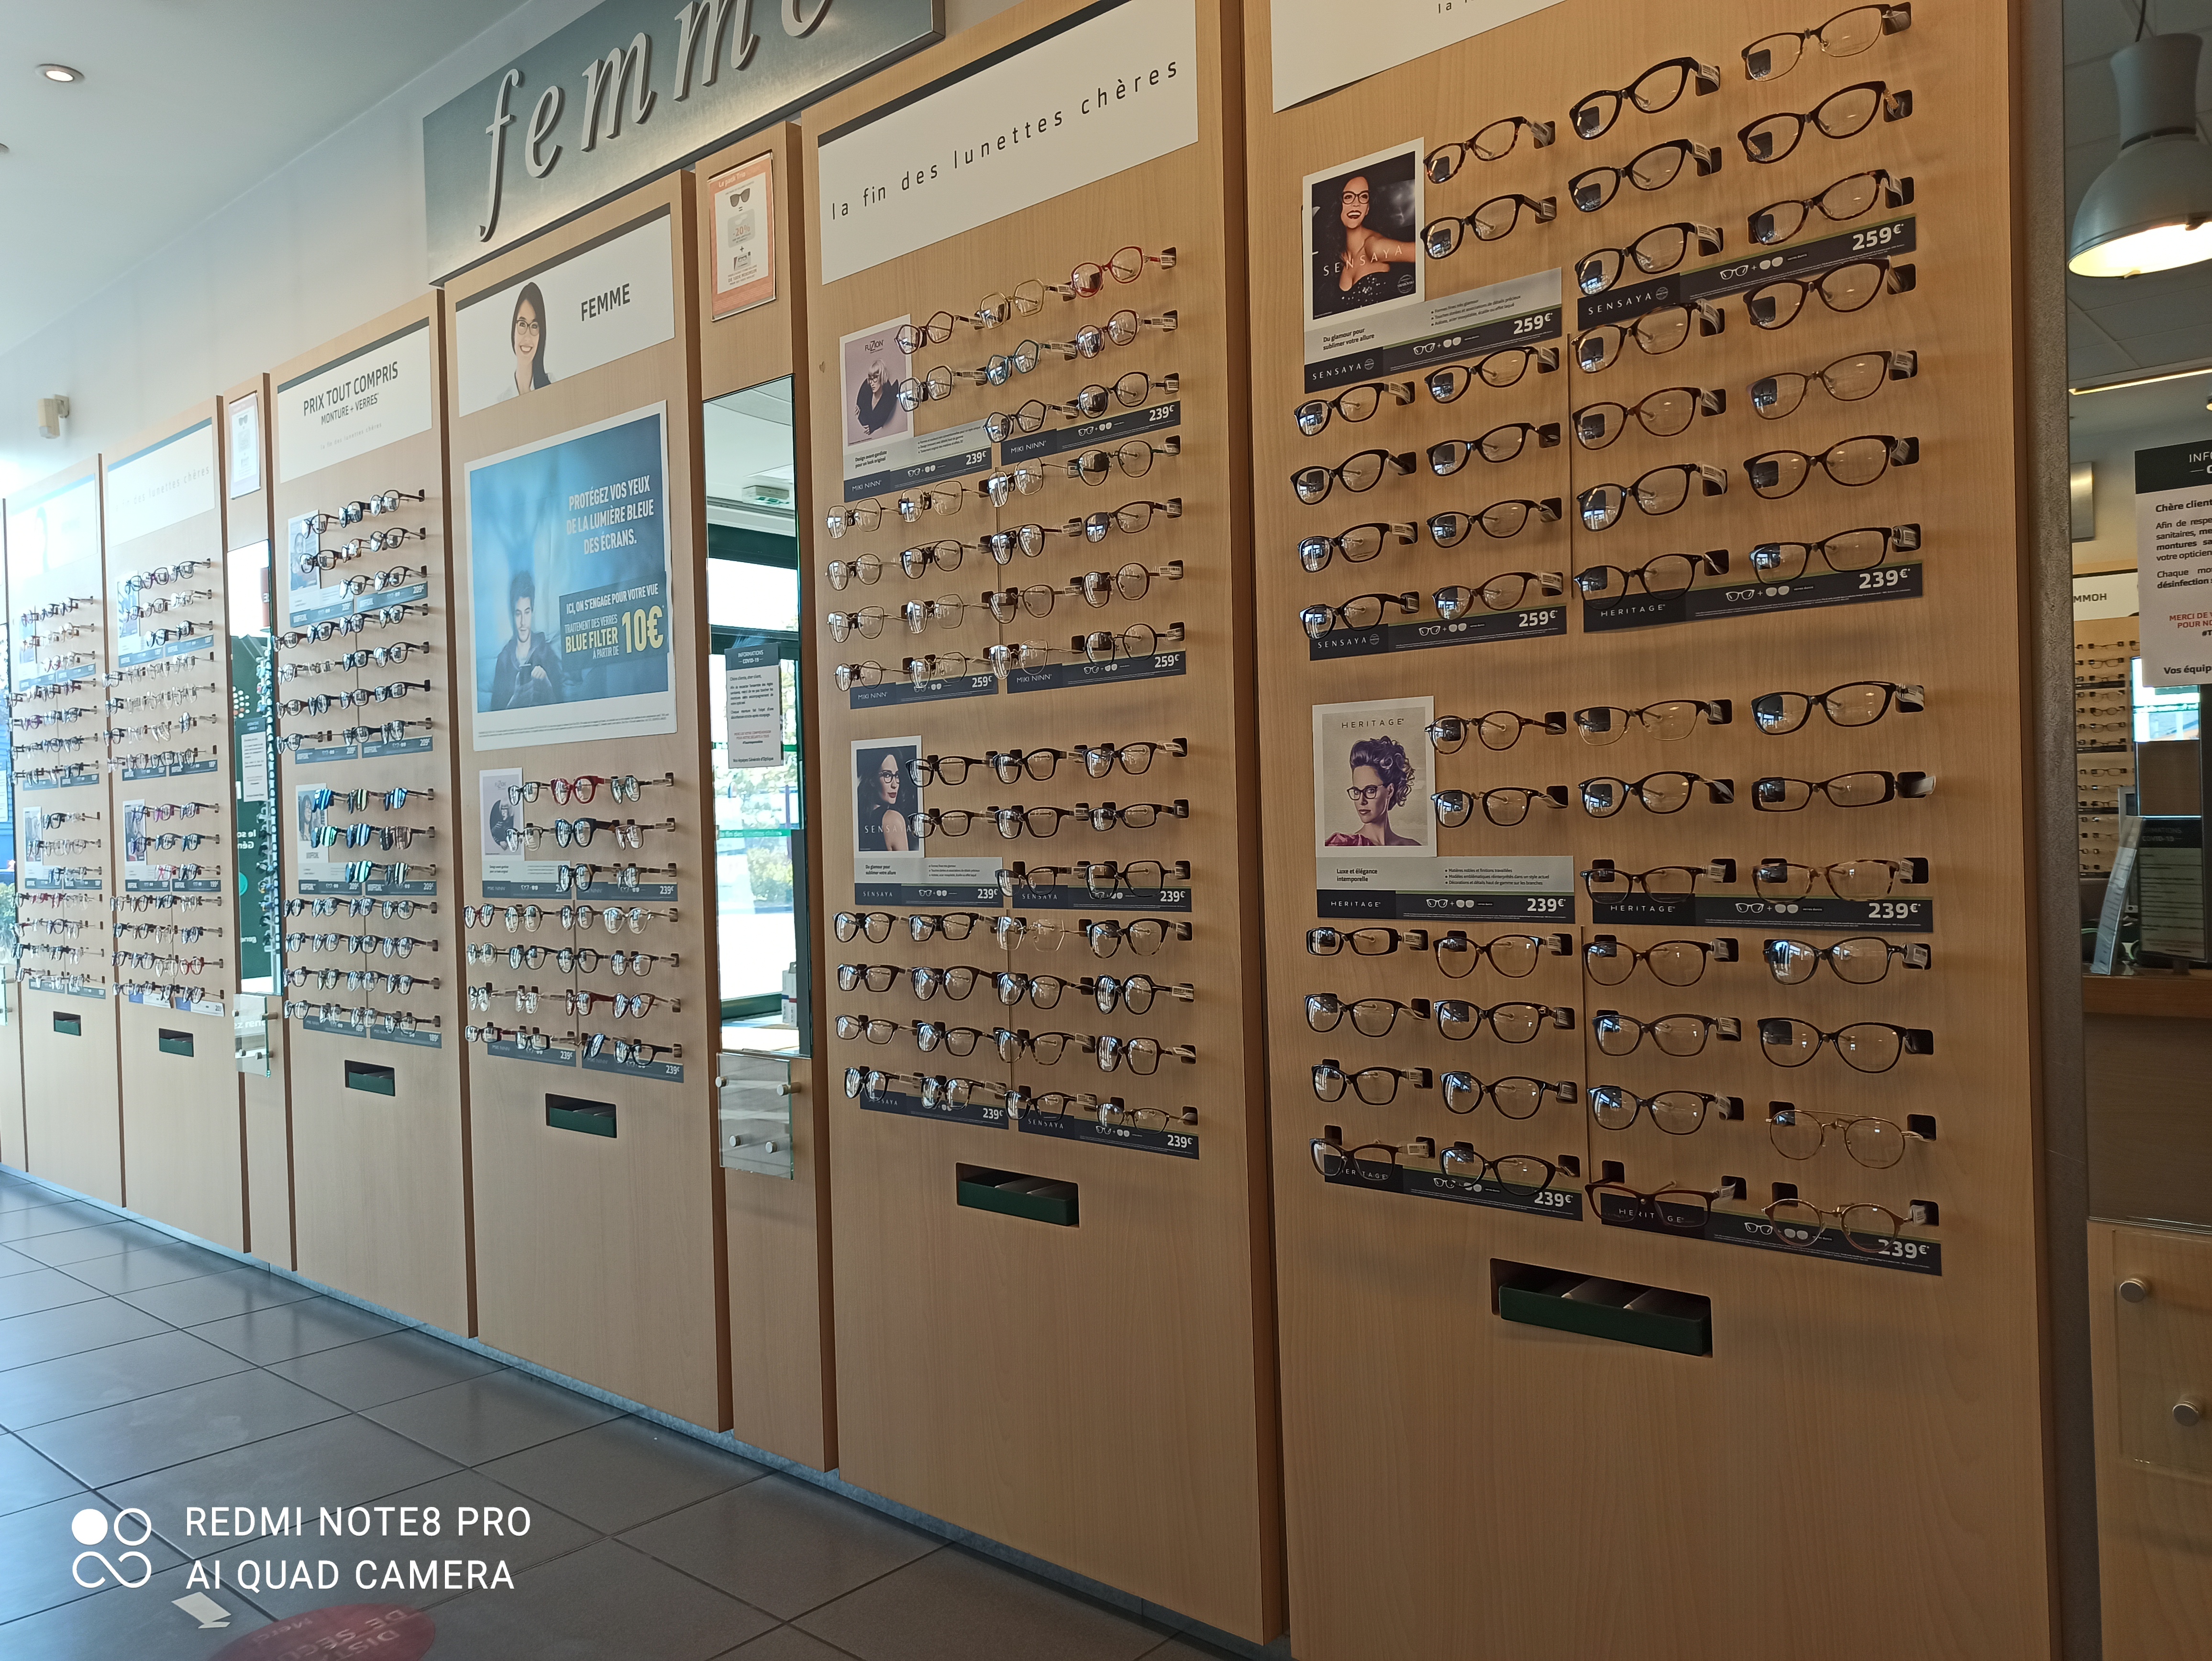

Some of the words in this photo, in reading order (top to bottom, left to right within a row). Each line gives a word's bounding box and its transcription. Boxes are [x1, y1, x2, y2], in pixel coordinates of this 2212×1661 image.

[1438, 1, 1452, 13] la
[832, 203, 849, 220] la
[863, 185, 886, 207] fin
[901, 164, 939, 191] des
[953, 109, 1063, 168] lunettes
[1081, 60, 1178, 114] chères
[1324, 245, 1403, 276] SENSAYA
[581, 283, 630, 321] FEMME
[1588, 292, 1651, 315] SENSAYA
[1323, 340, 1345, 350] sublimer
[1360, 333, 1375, 342] allure
[1331, 332, 1352, 342] glamour
[1352, 328, 1365, 338] pour
[1312, 363, 1362, 380] SENSAYA
[304, 393, 324, 416] PRIX
[326, 381, 351, 407] TOUT
[354, 361, 398, 395] COMPRIS
[321, 405, 349, 425] MONTURE
[1149, 405, 1174, 421] 239€
[1011, 445, 1024, 454] MIKI
[966, 451, 987, 465] 239€
[184, 466, 209, 483] chères
[569, 486, 609, 511] PROTÉGEZ
[610, 482, 627, 501] VOS
[628, 475, 651, 496] YEUX
[2156, 503, 2184, 512] Chère
[566, 518, 577, 535] DE
[578, 515, 589, 532] LA
[590, 505, 625, 530] LUMIÈRE
[627, 499, 654, 521] BLEUE
[2176, 519, 2187, 527] de
[2156, 529, 2196, 540] sanitaires,
[584, 536, 599, 554] DES
[601, 531, 637, 551] ÉCRANS.
[2157, 541, 2197, 551] montures
[2156, 552, 2178, 561] votre
[2157, 570, 2189, 578] Chaque
[2157, 576, 2209, 589] désinfection
[566, 602, 575, 615] ICI,
[576, 600, 584, 612] ON
[585, 594, 611, 610] S'ENGAGE
[611, 590, 628, 604] POUR
[627, 586, 646, 600] VOTRE
[646, 583, 659, 597] VUE
[1601, 604, 1663, 617] HERITAGE
[2169, 613, 2195, 621] MERCI
[591, 618, 600, 629] DES
[600, 614, 618, 627] VERRES
[565, 632, 587, 653] BLUE
[588, 627, 619, 649] FILTER
[1318, 637, 1367, 649] SENSAYA
[597, 647, 613, 659] PARTIR
[613, 645, 619, 655] DE
[1154, 655, 1179, 668] 259€
[2164, 666, 2181, 675] Vos
[972, 675, 993, 688] 259€
[1016, 675, 1031, 684] MIKI
[1341, 718, 1402, 729] HERITAGE
[864, 824, 911, 834] SENSAYA
[660, 886, 674, 895] 239€
[977, 888, 998, 899] 239€
[1160, 891, 1186, 902] 239€
[560, 1051, 573, 1060] 239€
[665, 1064, 680, 1074] 239€
[983, 1107, 1004, 1120] 239€
[1028, 1118, 1064, 1129] SENSAYA
[1167, 1135, 1193, 1149] 239€
[1339, 1169, 1386, 1180] ERTAGE
[1619, 1208, 1681, 1223] HERITGE
[365, 1609, 407, 1628] DE
